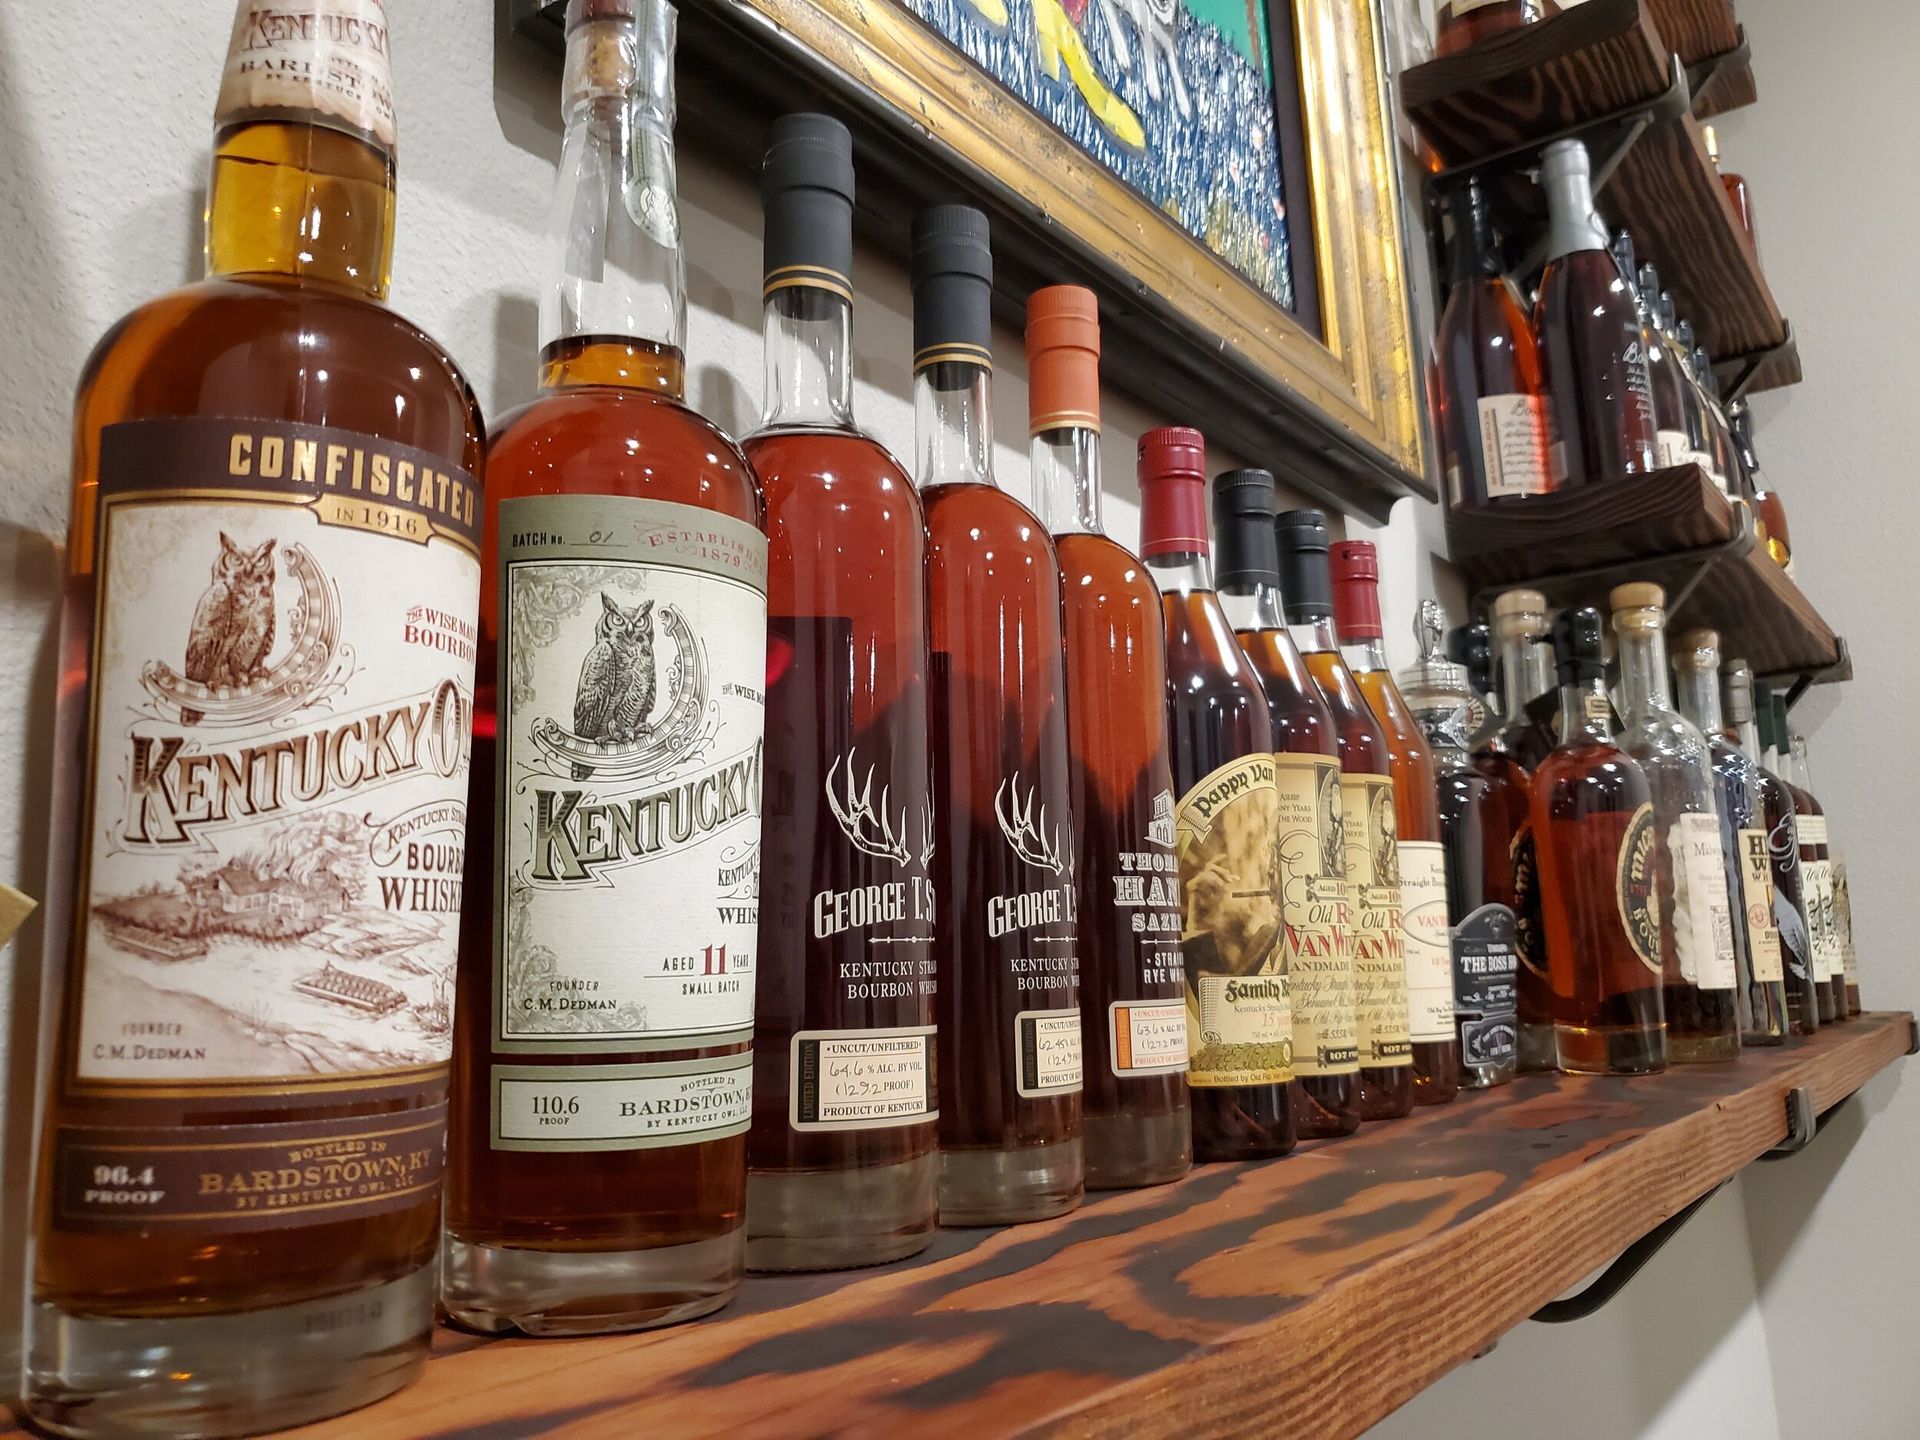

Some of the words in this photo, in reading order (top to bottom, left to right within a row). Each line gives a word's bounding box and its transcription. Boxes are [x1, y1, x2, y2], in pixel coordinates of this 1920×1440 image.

[229, 433, 475, 528] CONFISCATED
[336, 508, 354, 521] IN
[361, 509, 417, 536] 1916
[512, 532, 547, 548] BATCH
[702, 547, 741, 567] 1879
[406, 608, 423, 622] THE
[425, 607, 458, 633] WISE
[404, 624, 475, 666] BOURBON
[734, 684, 755, 701] WISE
[123, 701, 430, 845] KENTUCKY
[1249, 763, 1274, 783] Van
[531, 755, 753, 881] KENTUCKY
[1290, 814, 1312, 823] WOOD
[386, 808, 450, 853] KENTUCKY
[814, 882, 905, 939] GEORGE
[987, 889, 1061, 938] GEORGE
[1309, 904, 1333, 923] Old
[1361, 911, 1385, 929] Old
[1285, 924, 1331, 957] VAN
[662, 956, 695, 971] AGED
[701, 943, 728, 975] 11
[1010, 958, 1068, 972] KENTUCKY
[1460, 957, 1487, 974] THE
[1488, 955, 1507, 972] BOSS
[840, 961, 914, 978] KENTUCKY
[1144, 968, 1165, 984] RYE
[550, 981, 600, 992] FOUNDER
[682, 982, 713, 995] SMALL
[718, 980, 740, 993] BATCH
[848, 982, 913, 999] BOURBON
[1017, 976, 1068, 991] BOURBON
[1225, 979, 1280, 1002] Family
[121, 1022, 183, 1037] FOUNDER
[829, 1060, 864, 1077] 64.6
[898, 1063, 908, 1072] BY
[680, 1077, 725, 1092] BOTTLED
[1240, 1075, 1248, 1083] by
[532, 1096, 579, 1115] 110.6
[823, 1105, 872, 1116] PRODUCT
[874, 1104, 885, 1114] OF
[888, 1101, 923, 1113] KENTUCKY
[539, 1116, 570, 1126] PROOF
[647, 1119, 660, 1128] BY
[667, 1113, 718, 1127] KENTUCKY
[288, 1141, 366, 1163] BOTTLED
[371, 1141, 387, 1152] IN
[410, 1149, 432, 1170] KY
[85, 1190, 165, 1204] PROOF
[237, 1197, 256, 1208] BY
[268, 1187, 353, 1205] KENTUCKY
